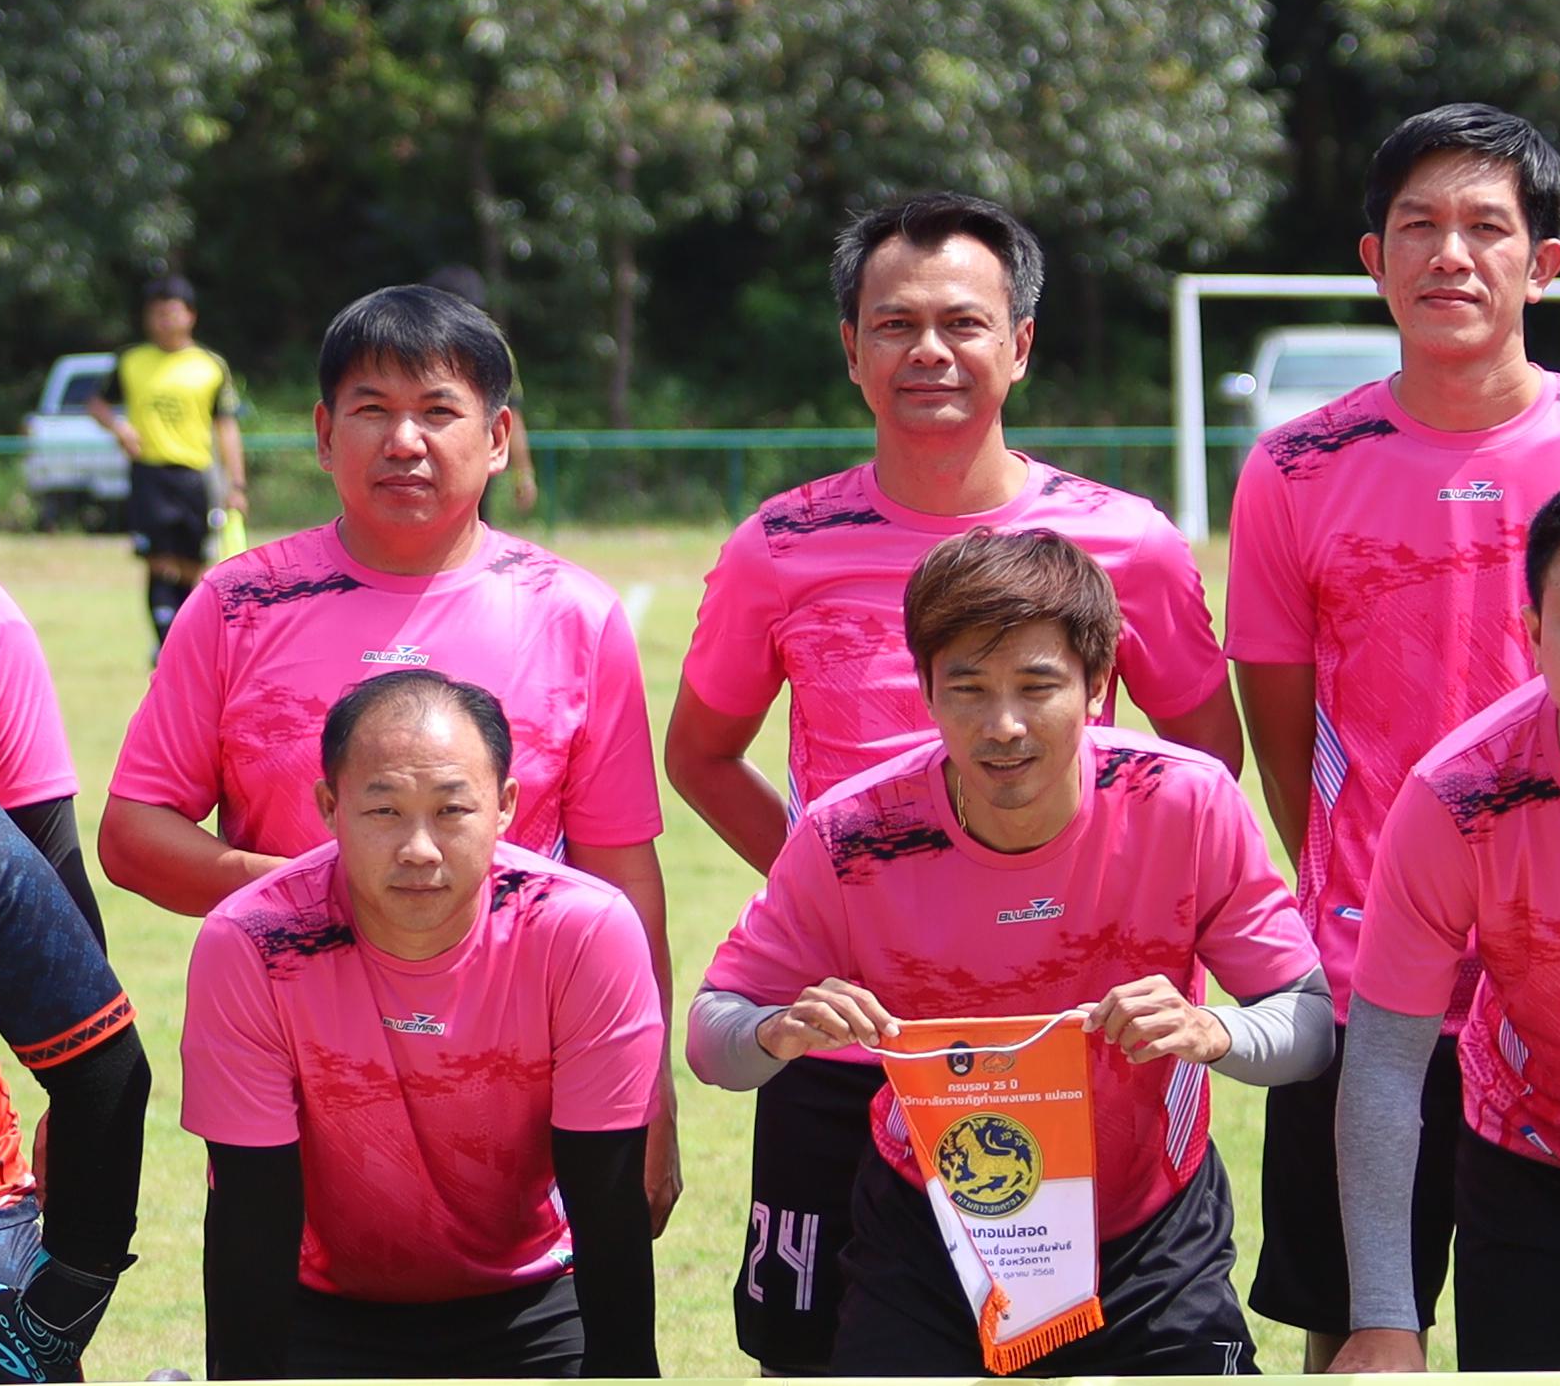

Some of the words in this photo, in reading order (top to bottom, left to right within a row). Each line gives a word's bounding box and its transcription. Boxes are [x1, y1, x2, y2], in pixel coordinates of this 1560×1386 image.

[1437, 489, 1504, 502] BLUEMAN
[361, 650, 430, 666] BLUEMAN
[996, 902, 1065, 924] BLUEMAN
[993, 1081, 1007, 1091] 25
[1010, 1079, 1018, 1089] ปี
[748, 1201, 819, 1310] 24
[1032, 1267, 1055, 1277] 2568
